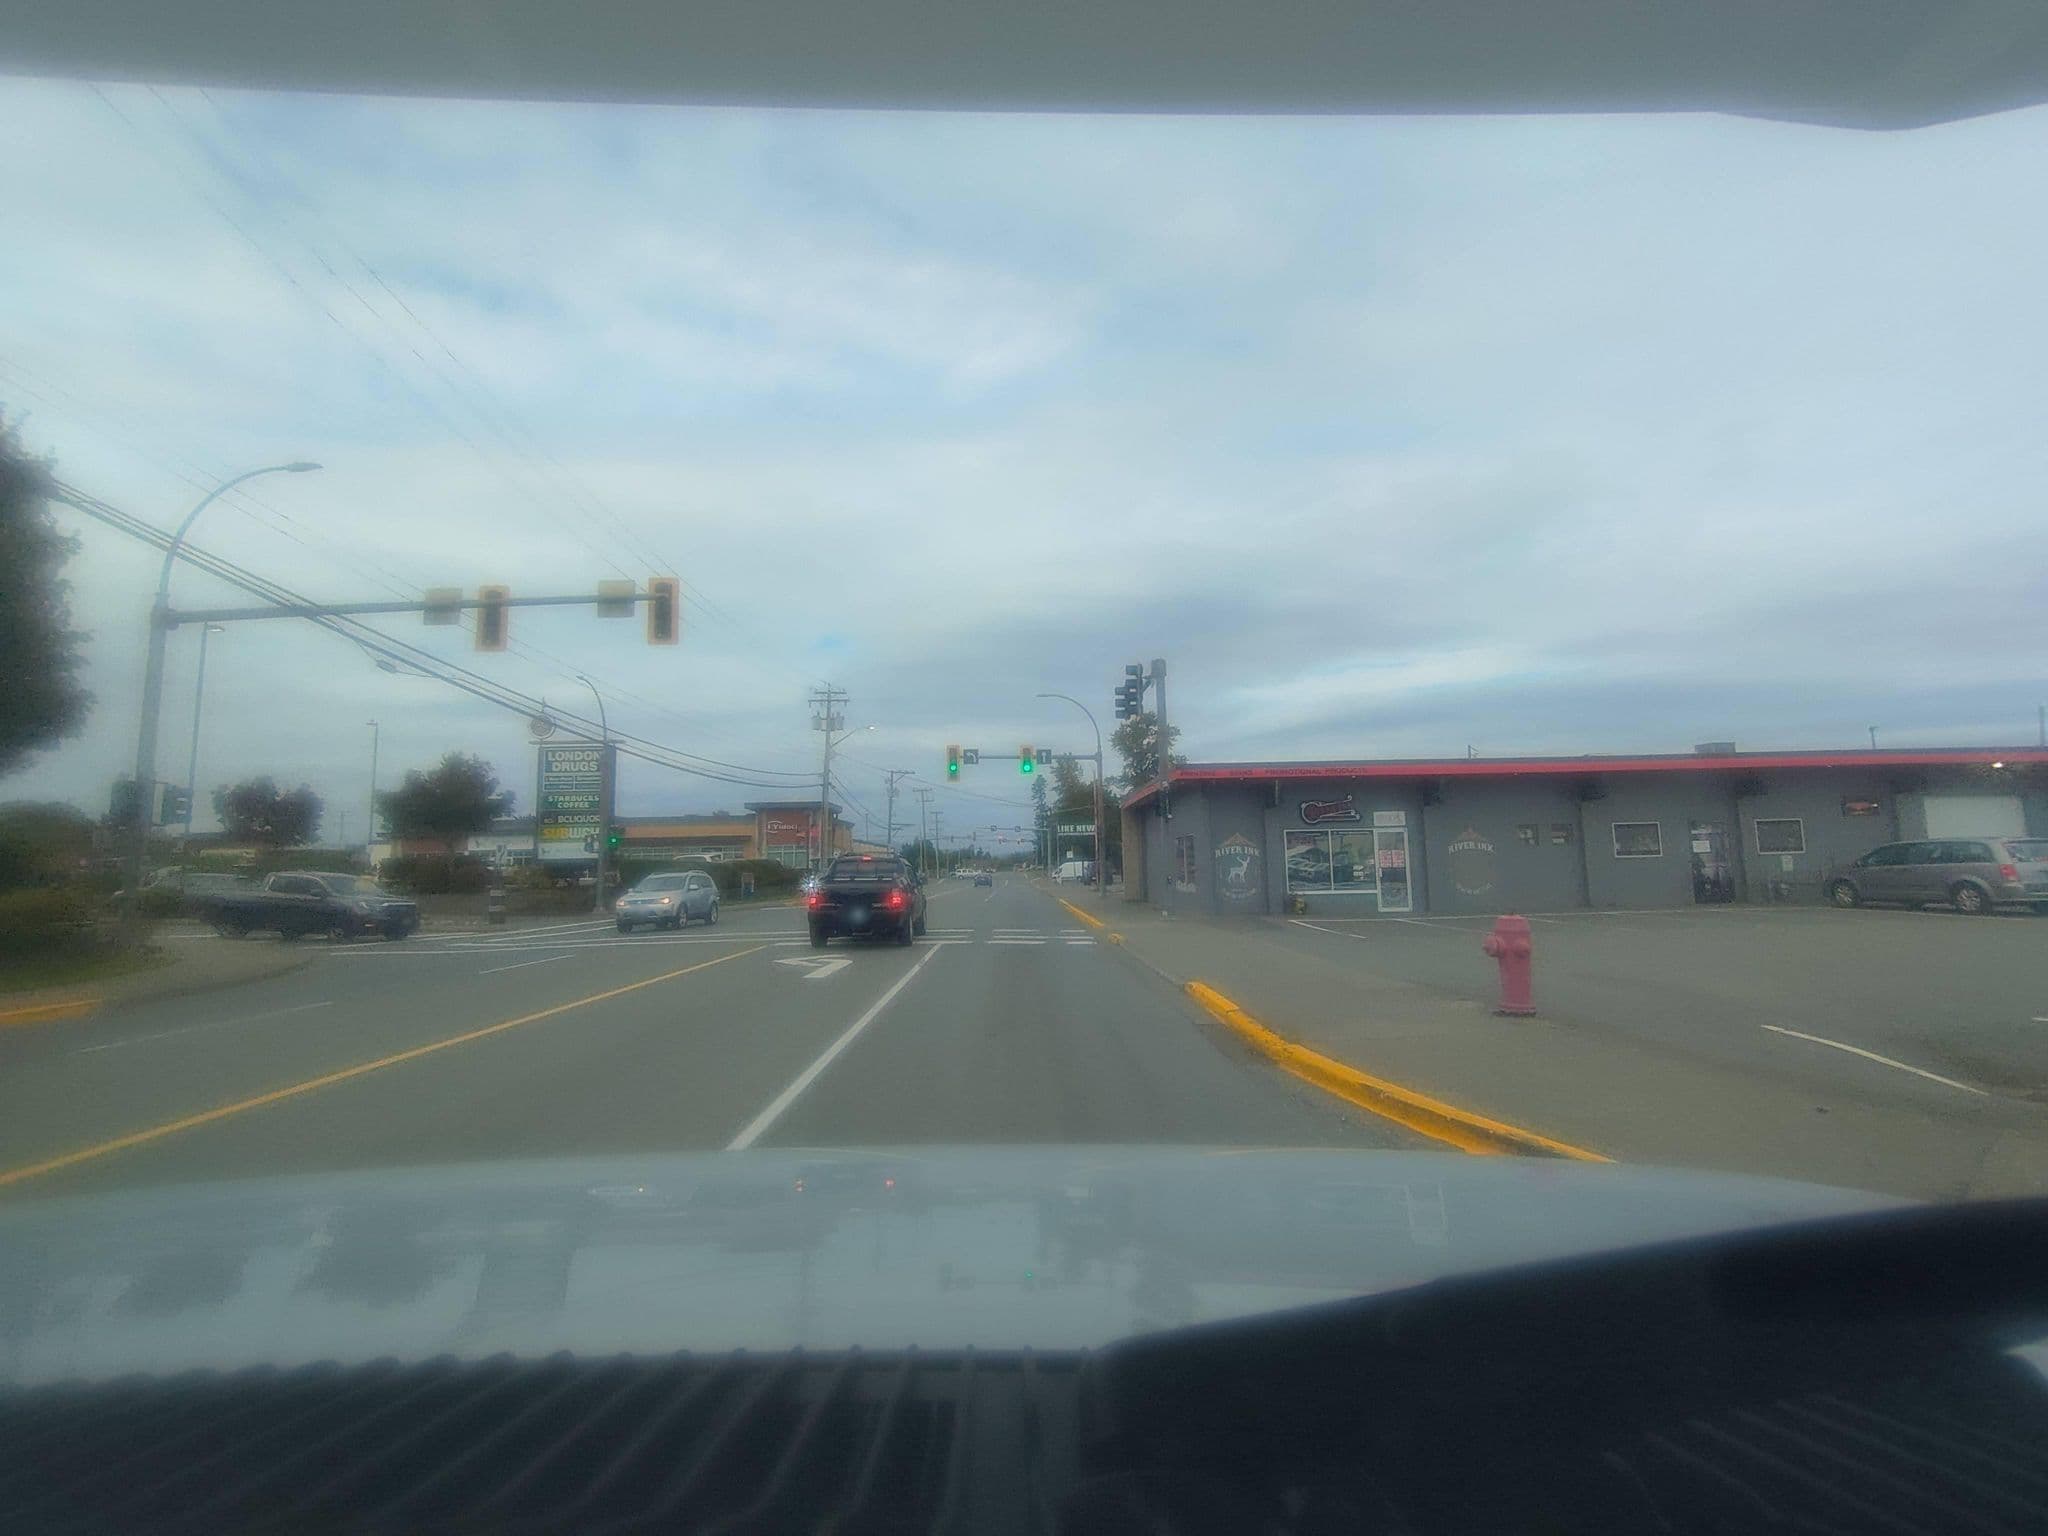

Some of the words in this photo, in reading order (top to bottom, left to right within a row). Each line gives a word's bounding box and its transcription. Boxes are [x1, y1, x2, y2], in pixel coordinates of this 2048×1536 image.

[548, 751, 600, 761] LONDON
[552, 761, 599, 771] DRUGS
[557, 801, 591, 809] COFFEE
